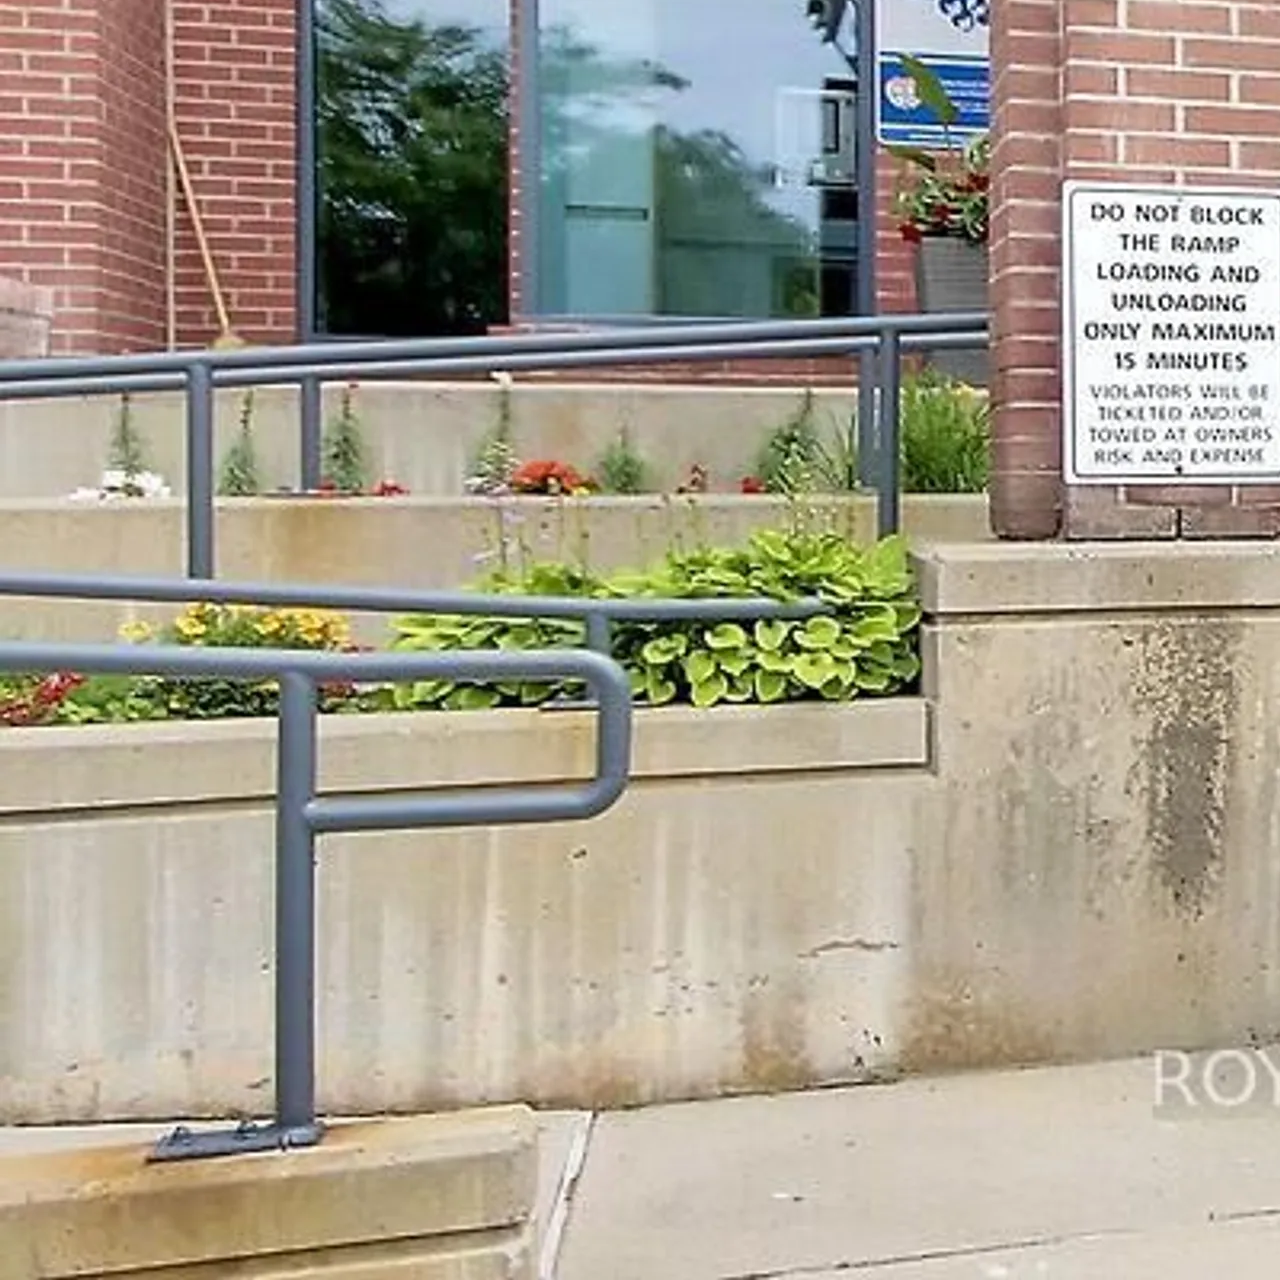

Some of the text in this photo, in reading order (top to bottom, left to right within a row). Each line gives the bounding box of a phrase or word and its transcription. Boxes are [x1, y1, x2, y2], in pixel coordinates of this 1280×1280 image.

[1090, 203, 1265, 225] DO NOT BLOCK
[1119, 233, 1241, 253] THE RAMP
[1097, 262, 1261, 284] LOADING AND
[1111, 293, 1247, 313] UNLOADING
[1084, 322, 1276, 342] ONLY MAXIMUM
[1115, 352, 1249, 371] 15 MINUTES
[1089, 384, 1269, 400] VIOLATORS WILL BE
[1098, 405, 1263, 421] TICKETED AND/OR
[1089, 426, 1273, 443] TOWED AT OWNERS
[1094, 448, 1265, 464] RISK AND EXPENSE
